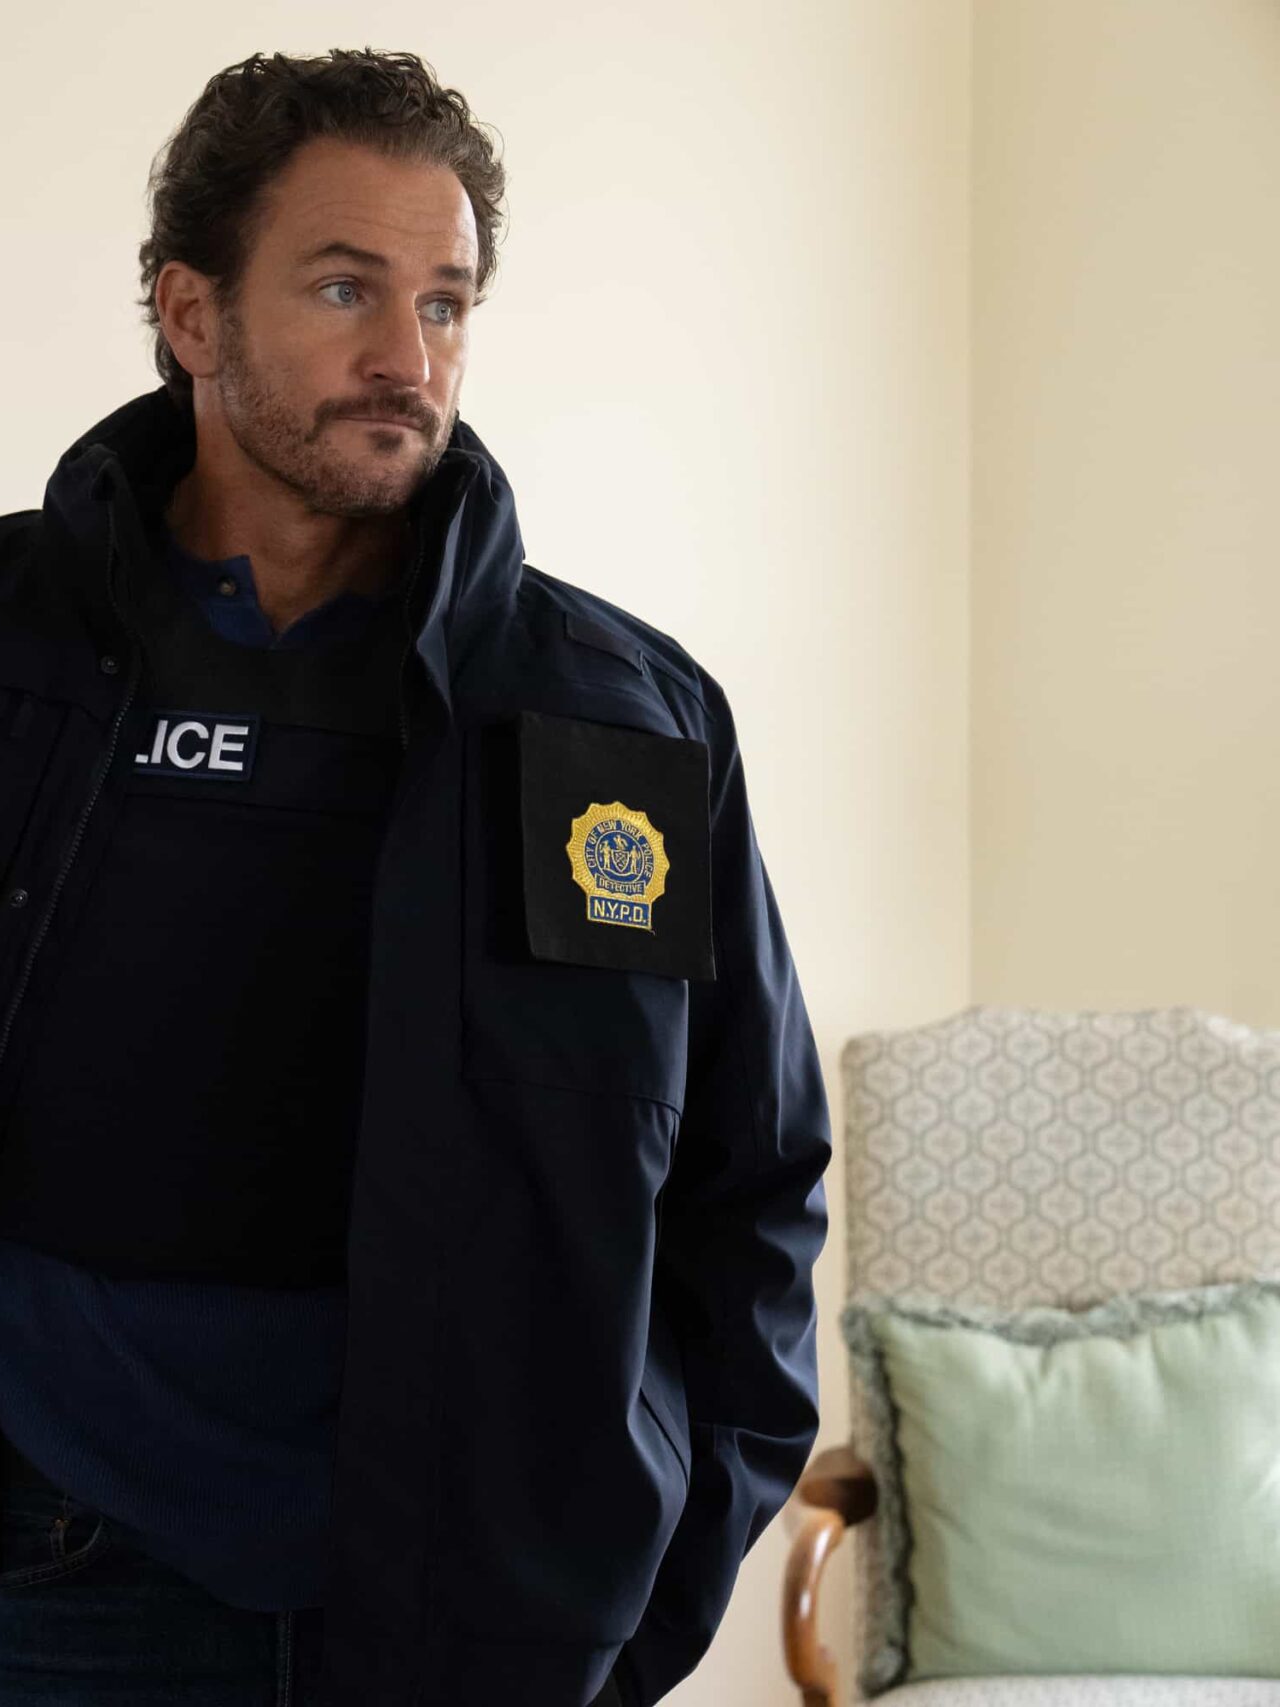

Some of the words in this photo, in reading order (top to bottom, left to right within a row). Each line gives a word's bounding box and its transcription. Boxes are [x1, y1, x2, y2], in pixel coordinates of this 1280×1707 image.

[135, 720, 249, 771] ICE
[597, 820, 617, 833] NEW
[621, 821, 642, 841] YORK
[588, 831, 598, 845] OF
[586, 848, 597, 868] CITY
[642, 843, 653, 878] POLICE
[599, 879, 643, 893] DETECTIVE
[594, 900, 647, 923] N.Y.P.D.
